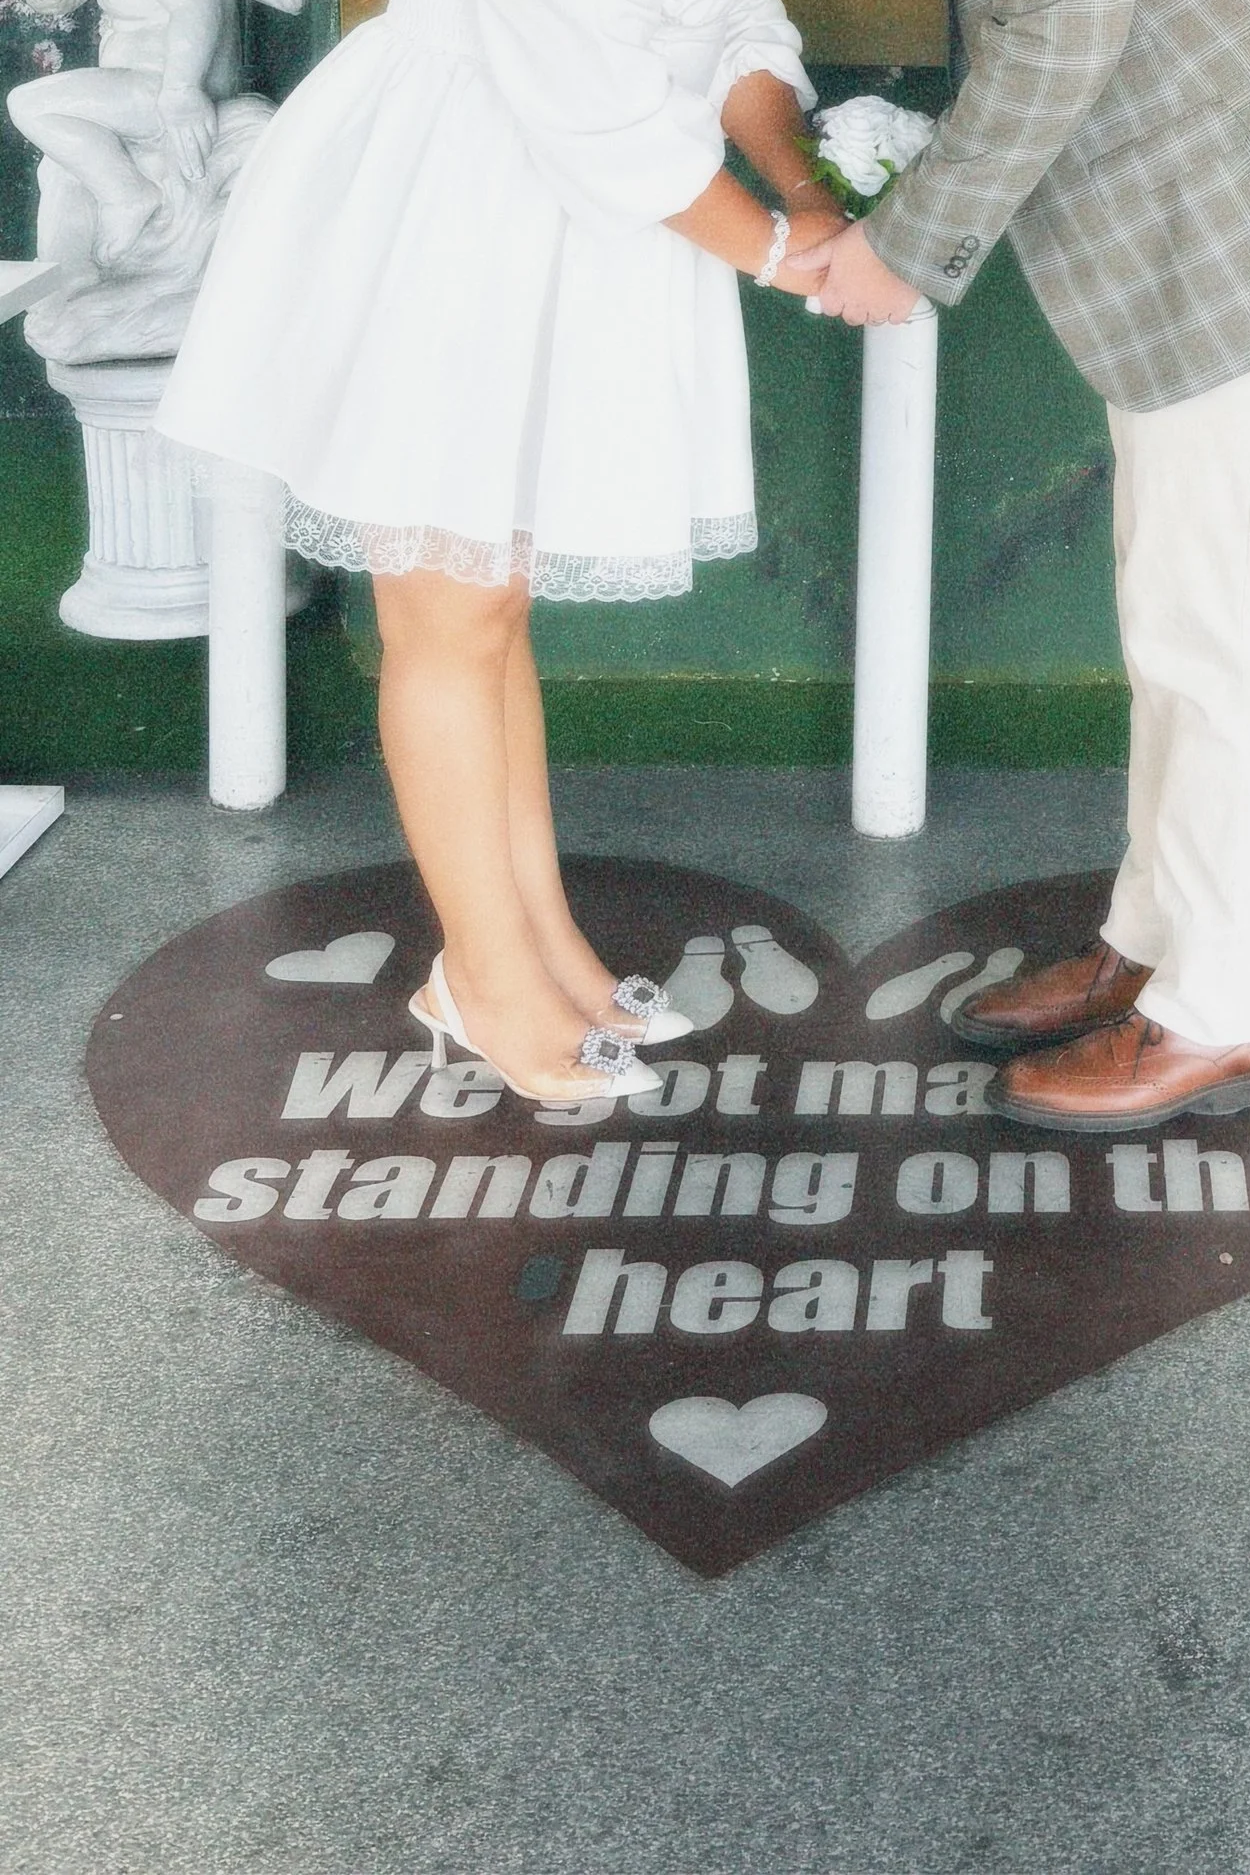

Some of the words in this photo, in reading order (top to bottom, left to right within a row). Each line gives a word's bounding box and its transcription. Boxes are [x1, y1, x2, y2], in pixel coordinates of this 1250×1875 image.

[279, 1050, 503, 1119] We
[193, 1138, 859, 1226] standing
[896, 1151, 1071, 1215] on
[562, 1248, 995, 1335] heart
